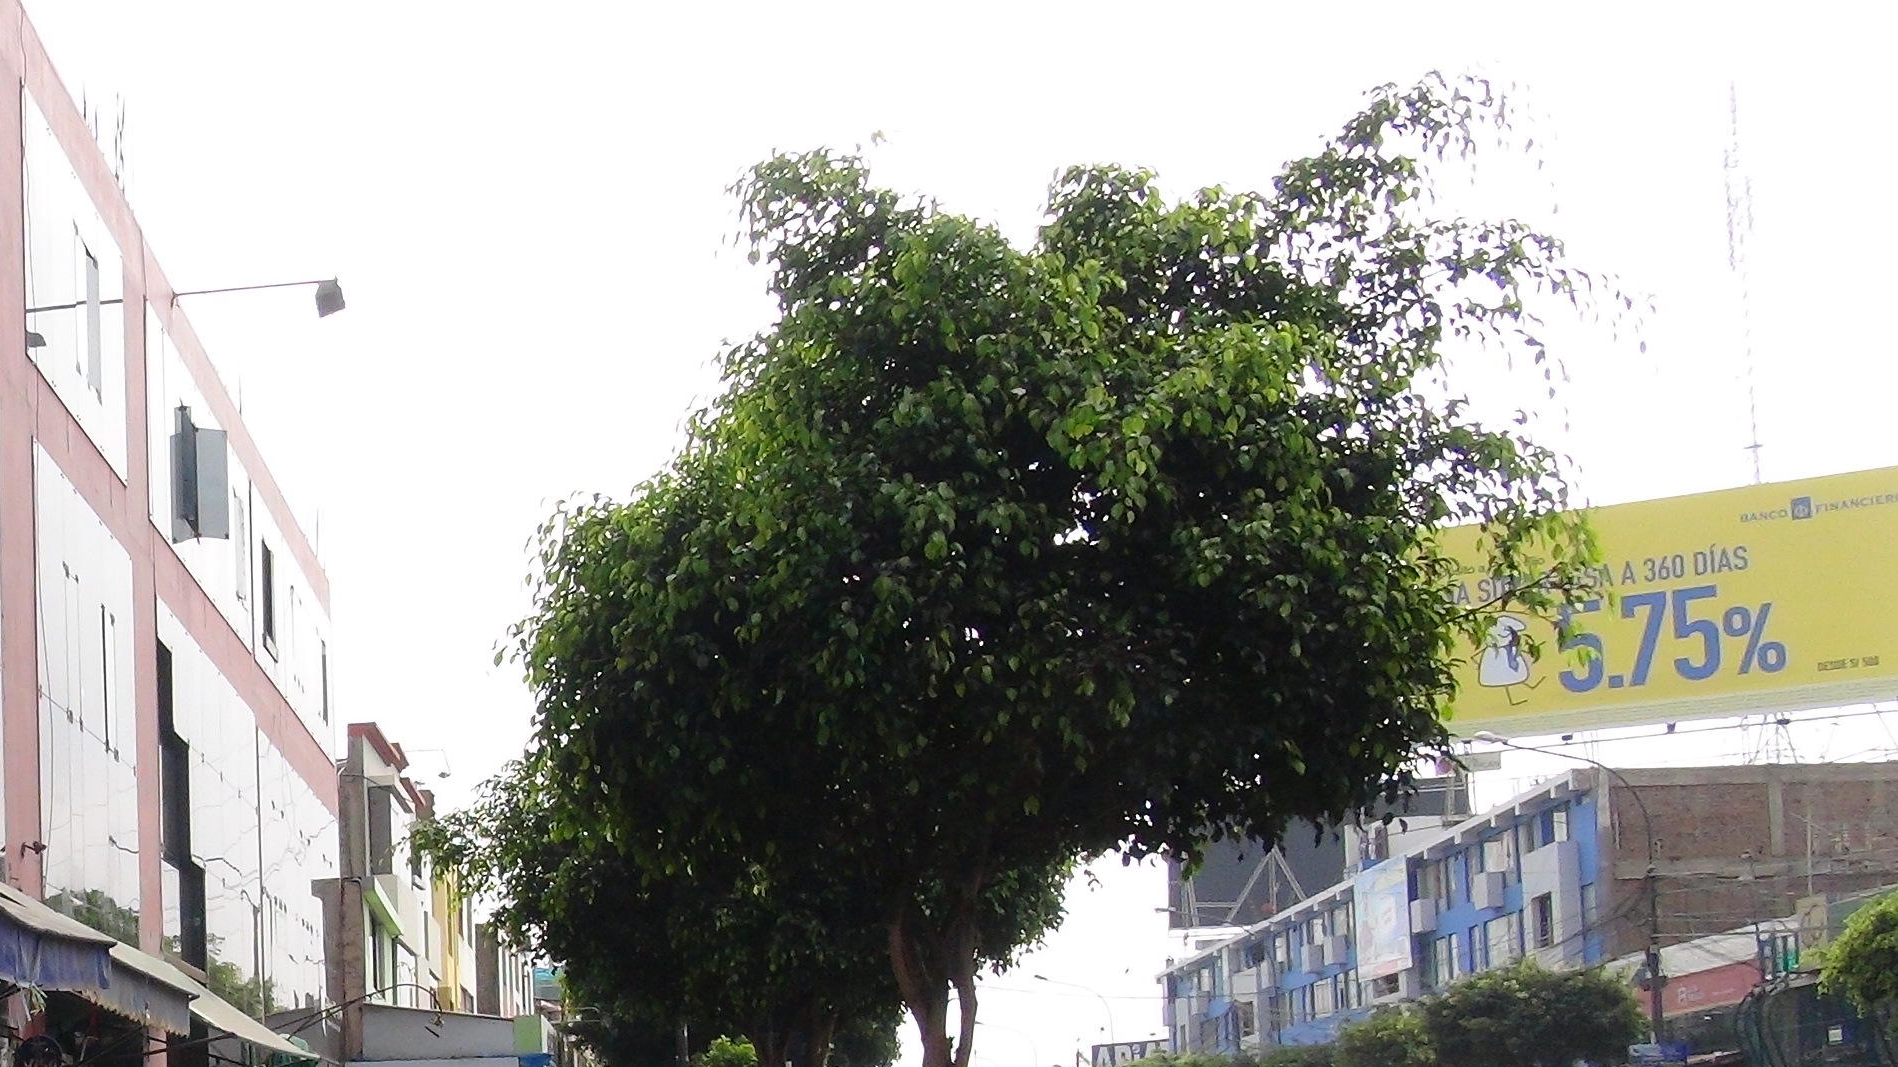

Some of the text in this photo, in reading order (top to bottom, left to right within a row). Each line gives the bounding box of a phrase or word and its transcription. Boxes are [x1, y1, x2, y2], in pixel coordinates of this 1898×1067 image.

[1739, 508, 1789, 523] BANCO
[1620, 560, 1637, 586] A
[1643, 553, 1685, 584] 360
[1693, 543, 1749, 577] DÍAS
[1557, 584, 1788, 694] 5.75%
